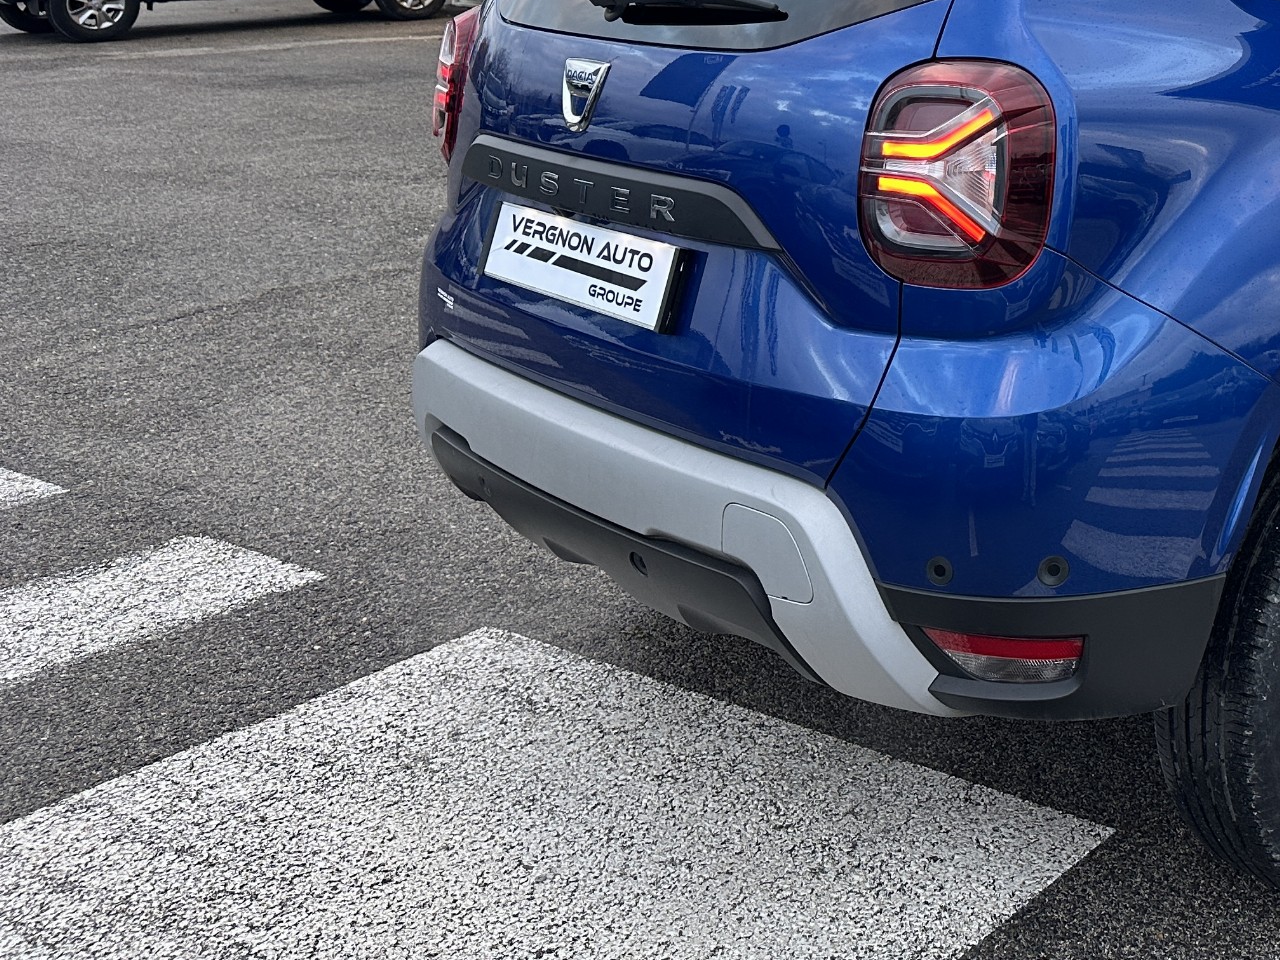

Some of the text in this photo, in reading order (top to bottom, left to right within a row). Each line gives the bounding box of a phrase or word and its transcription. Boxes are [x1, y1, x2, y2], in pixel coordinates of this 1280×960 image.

[566, 69, 594, 82] DACIA
[487, 154, 677, 222] DUSTER
[511, 213, 655, 274] VERGNON AUTO
[588, 284, 643, 313] GROUPE
